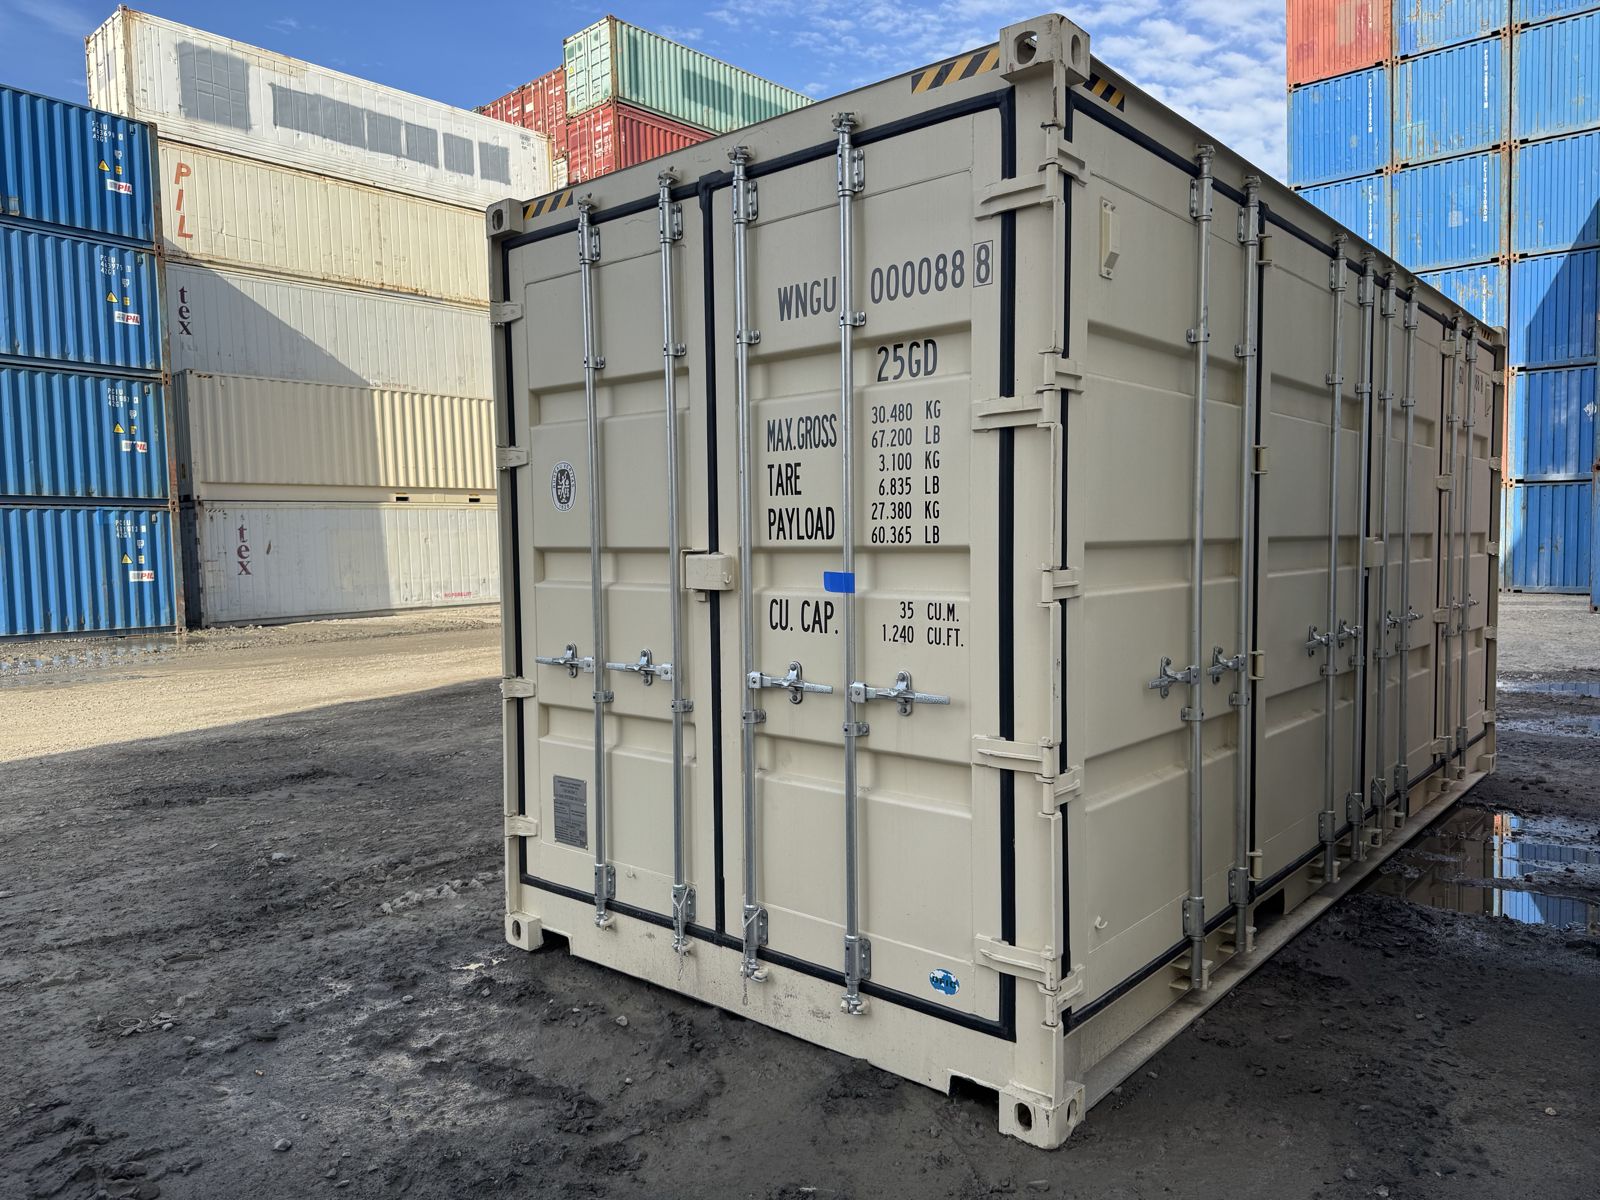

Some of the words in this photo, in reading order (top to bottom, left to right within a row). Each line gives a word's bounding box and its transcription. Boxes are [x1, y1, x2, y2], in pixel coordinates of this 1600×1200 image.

[117, 184, 132, 193] PIL
[174, 162, 193, 238] PIL
[778, 276, 837, 321] WNGU
[870, 249, 965, 304] 000088
[975, 244, 990, 283] 8
[125, 314, 140, 324] PIL
[178, 285, 192, 336] tex
[876, 339, 938, 382] 25GD
[767, 413, 837, 452] MAX.GROSS
[871, 403, 913, 424] 30.480
[925, 400, 941, 420] KG
[871, 428, 913, 448] 67.200
[925, 425, 941, 445] LB
[767, 462, 802, 496] TARE
[878, 453, 912, 472] 3.100
[924, 451, 940, 470] KG
[878, 477, 912, 496] 6.835
[924, 476, 940, 495] LB
[768, 506, 835, 540] PAYLOAD
[871, 501, 912, 520] 27.380
[924, 501, 940, 519] KG
[871, 526, 912, 544] 60.365
[924, 526, 940, 544] LB
[237, 524, 252, 575] tex
[140, 572, 154, 580] PIL
[769, 599, 794, 632] CU.
[801, 600, 839, 635] CAP.
[899, 601, 914, 619] 35
[927, 602, 960, 623] CU.M.
[882, 624, 914, 643] 1.240
[927, 627, 964, 647] CU.FT.
